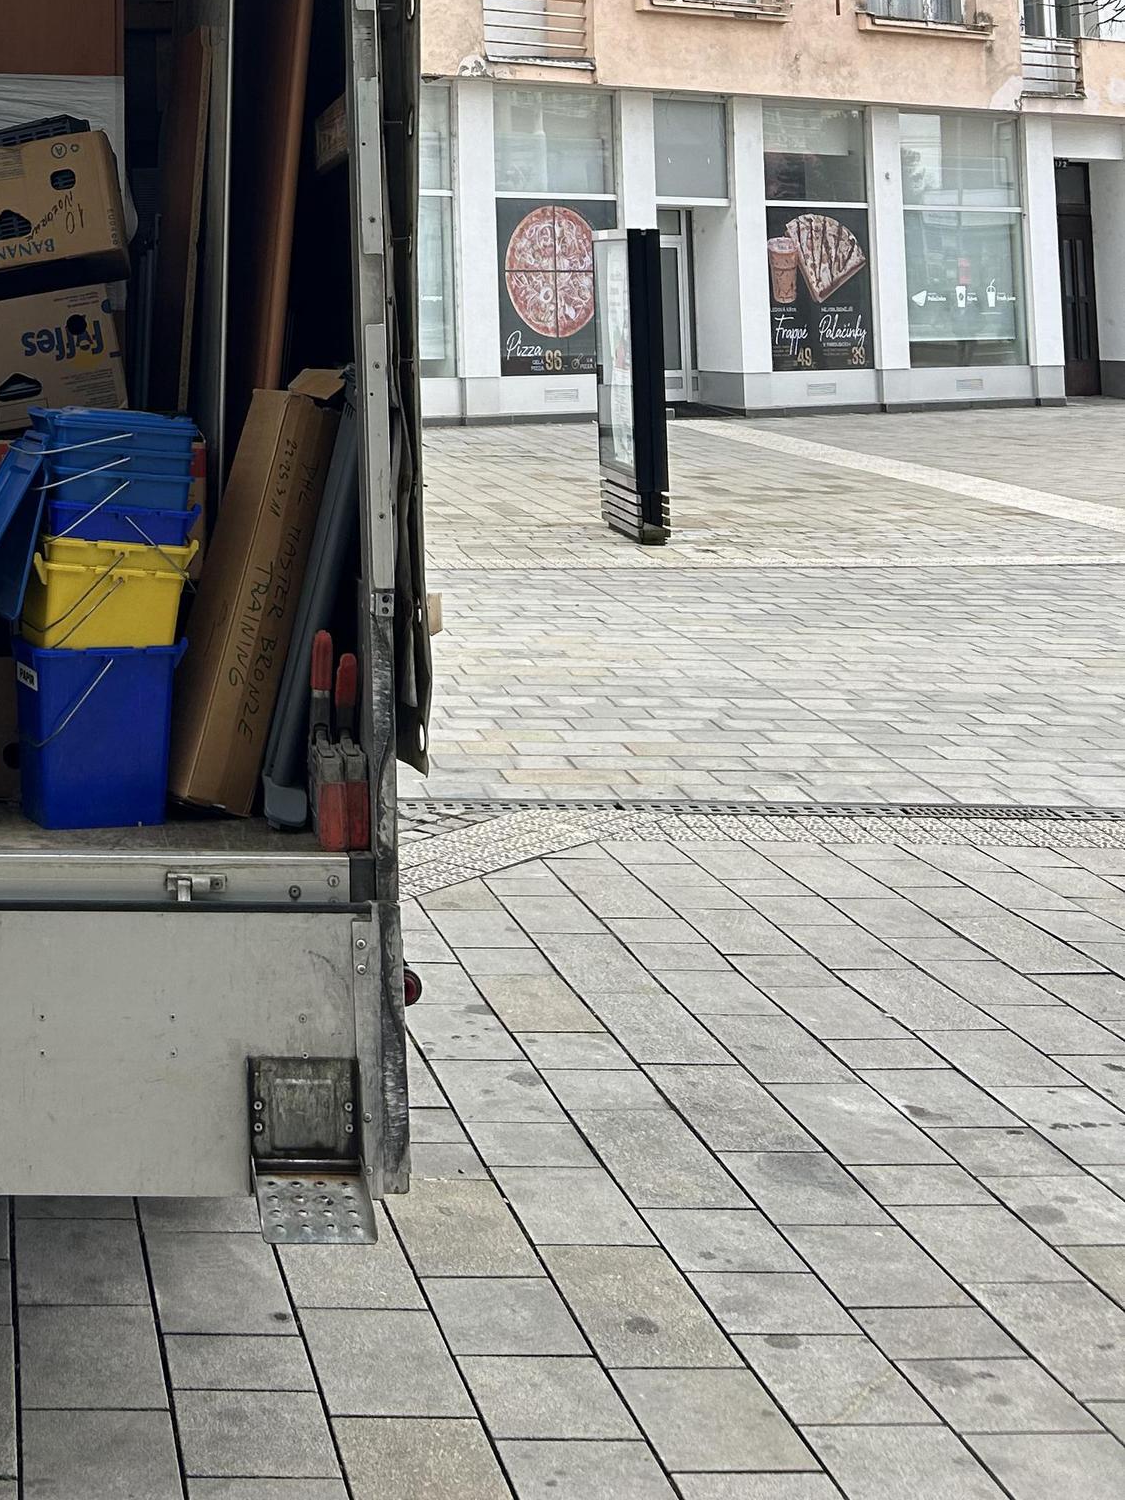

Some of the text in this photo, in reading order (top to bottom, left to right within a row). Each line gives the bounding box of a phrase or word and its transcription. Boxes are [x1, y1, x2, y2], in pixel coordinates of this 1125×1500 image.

[506, 330, 543, 360] Pizza
[774, 314, 809, 355] Frappé
[228, 561, 274, 687] TRAINING
[237, 462, 317, 744] DHL MASTER BRONZE
